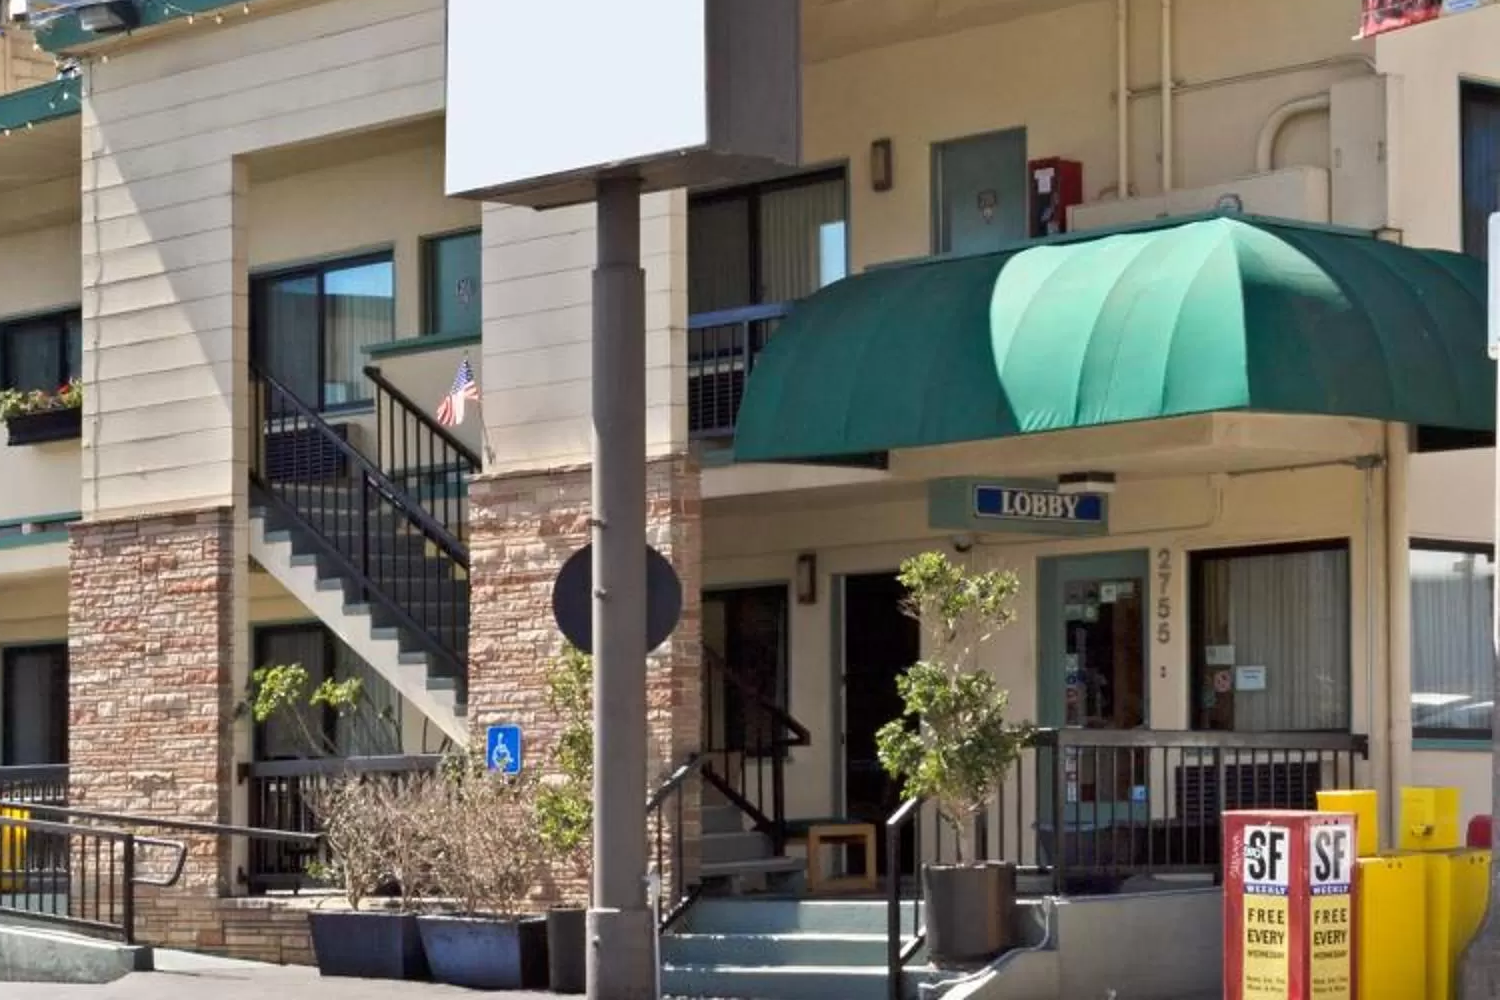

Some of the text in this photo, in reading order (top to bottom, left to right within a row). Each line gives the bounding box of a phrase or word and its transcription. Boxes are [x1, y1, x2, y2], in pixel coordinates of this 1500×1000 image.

[1002, 491, 1079, 519] LOBBY
[1156, 548, 1171, 644] 2755
[1249, 829, 1285, 880] SF
[1315, 829, 1347, 882] SF
[1246, 885, 1286, 894] WEEKLY
[1313, 885, 1349, 894] WEEKLY
[1247, 908, 1285, 924] FREE
[1314, 908, 1347, 924] FREE
[1247, 929, 1285, 945] EVERY
[1314, 929, 1347, 946] EVERY
